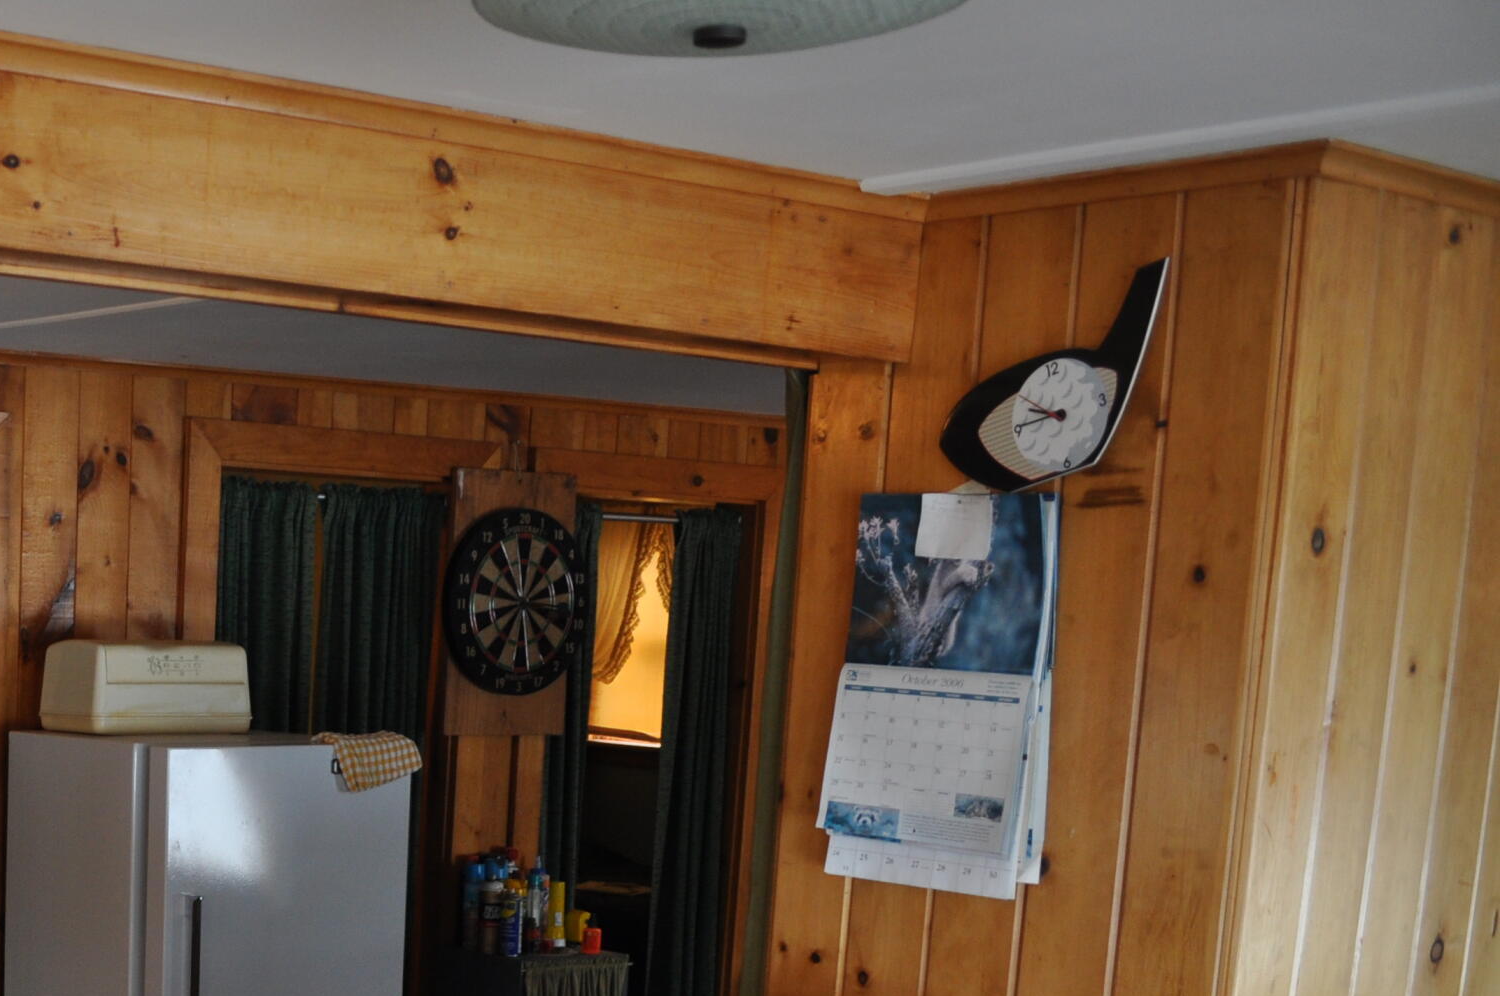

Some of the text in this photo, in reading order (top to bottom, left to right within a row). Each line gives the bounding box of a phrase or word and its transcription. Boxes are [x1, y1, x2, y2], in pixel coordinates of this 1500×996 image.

[1045, 362, 1059, 378] 12
[1099, 393, 1107, 407] 3
[1014, 424, 1022, 438] 9
[1064, 457, 1071, 469] 6
[520, 513, 531, 524] 20
[483, 531, 493, 543] 12
[554, 529, 564, 540] 18
[471, 550, 478, 560] 9
[568, 549, 574, 559] 4
[460, 573, 470, 584] 14
[457, 598, 466, 609] 11
[461, 624, 467, 634] 8
[466, 646, 476, 657] 16
[565, 642, 575, 653] 15
[901, 673, 938, 687] October
